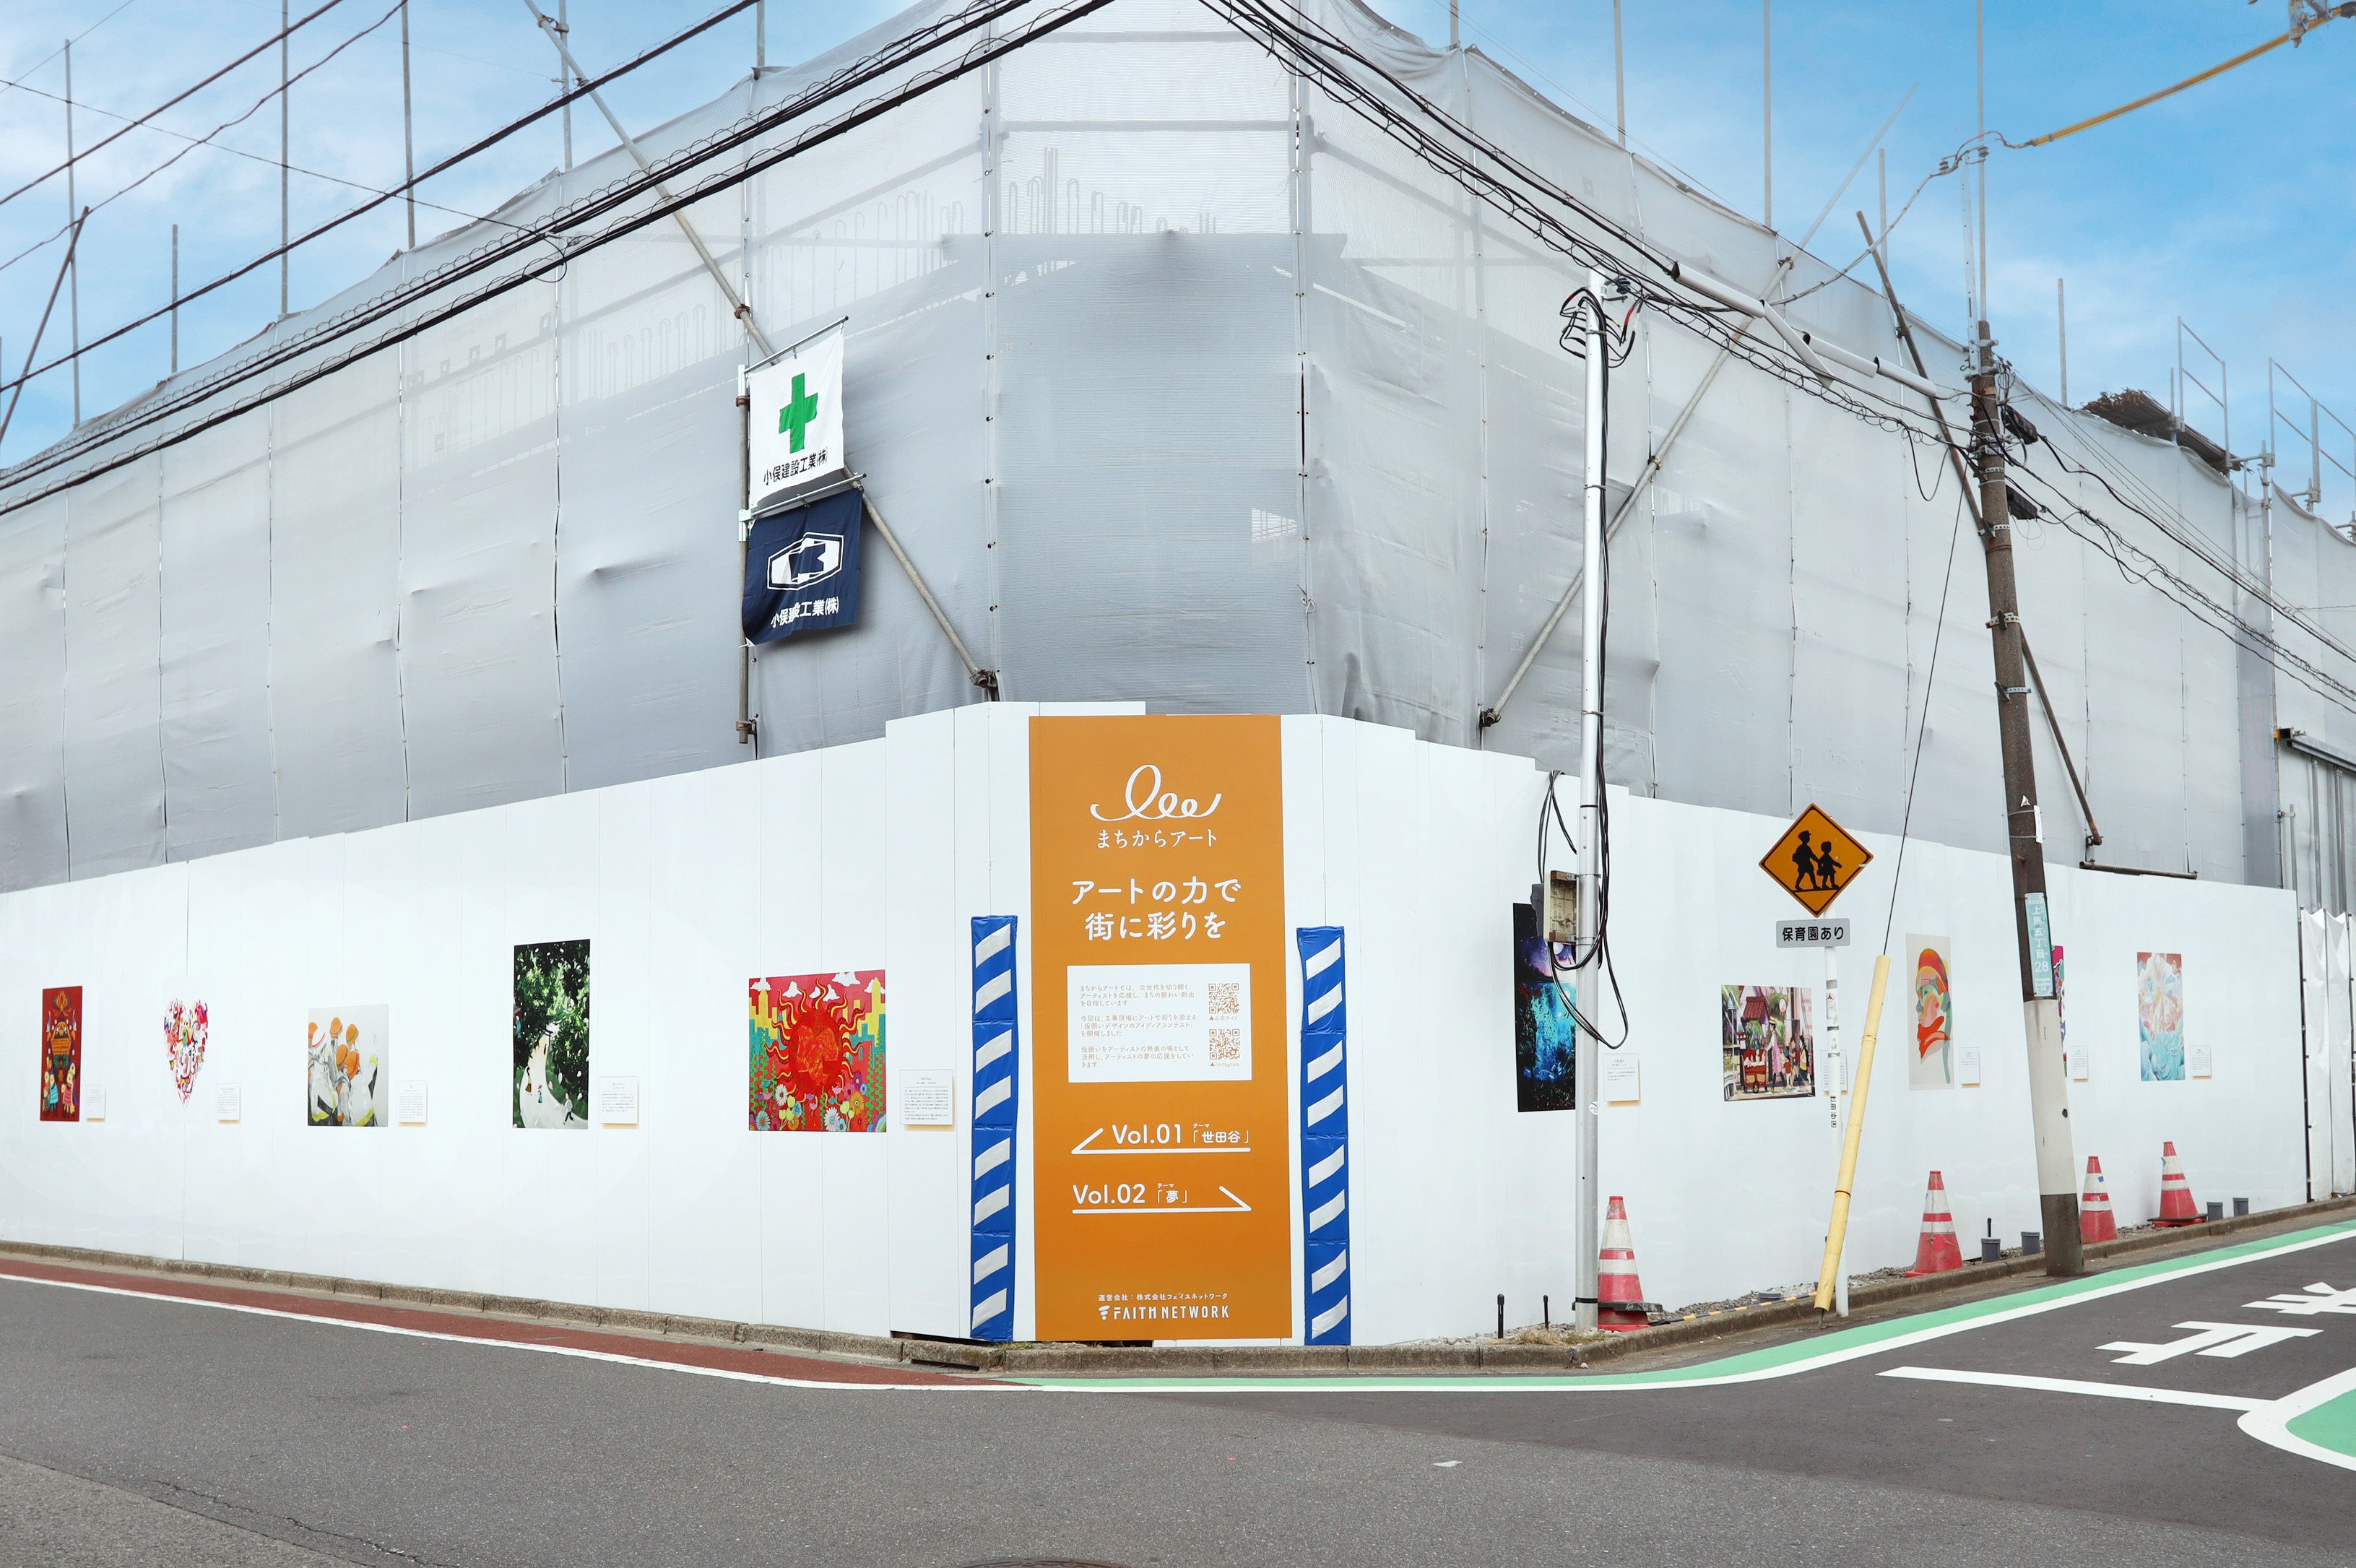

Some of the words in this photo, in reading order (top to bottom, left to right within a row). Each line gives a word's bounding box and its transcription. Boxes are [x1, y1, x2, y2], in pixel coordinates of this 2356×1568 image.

[1097, 828, 1217, 849] まちからアート
[1072, 875, 1242, 905] アートの力で
[1085, 911, 1226, 941] 街に彩りを
[1782, 926, 1844, 942] 保育園あり
[2034, 961, 2049, 972] 28
[1112, 1123, 1182, 1144] Vol.01
[1192, 1130, 1249, 1143] 「世田谷」
[1073, 1183, 1145, 1205] Vol.02
[1157, 1190, 1188, 1204] 「夢」
[1113, 1306, 1157, 1320] FAITH
[1161, 1305, 1229, 1319] NETWORK
